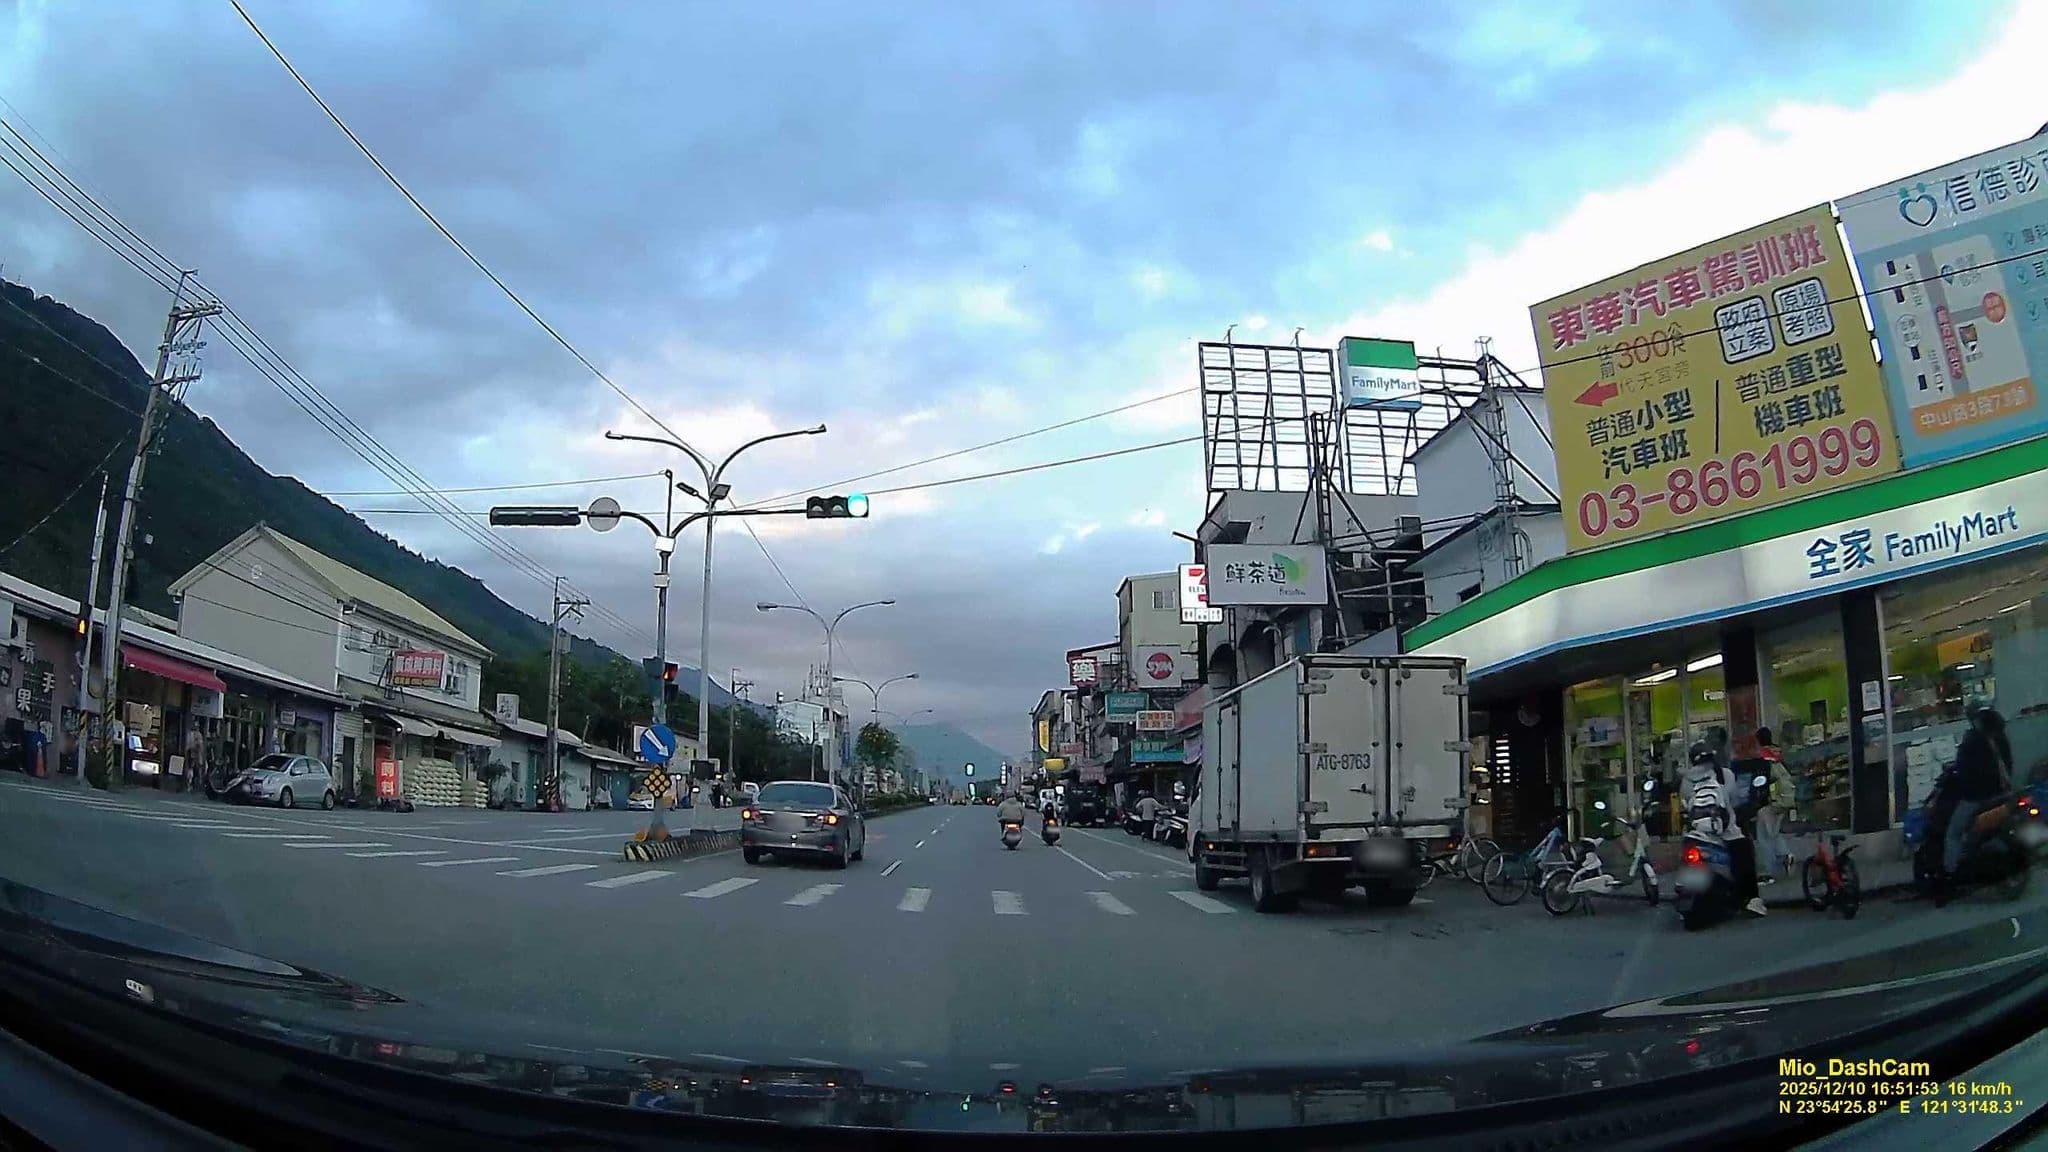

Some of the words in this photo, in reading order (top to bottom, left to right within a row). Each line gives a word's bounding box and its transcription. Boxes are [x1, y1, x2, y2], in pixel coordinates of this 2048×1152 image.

[1547, 226, 1828, 351] 東華汽車駕訓班
[1779, 281, 1822, 312] 原場
[1719, 301, 1763, 333] 政府
[1784, 307, 1830, 338] 考照
[1616, 329, 1671, 369] 300
[1727, 326, 1771, 357] 立案
[1351, 375, 1418, 392] FamilyMart
[1735, 343, 1848, 404] 普通重型
[1586, 388, 1695, 448] 普通小型
[1753, 384, 1846, 438] 機車班
[1602, 428, 1692, 480] 汽車班
[1578, 417, 1881, 538] 03-8661999
[1806, 527, 1875, 579] 全家
[1885, 505, 2019, 562] FamilyMart
[1225, 561, 1287, 585] 鮮茶道
[1316, 753, 1371, 771] ATG-8763
